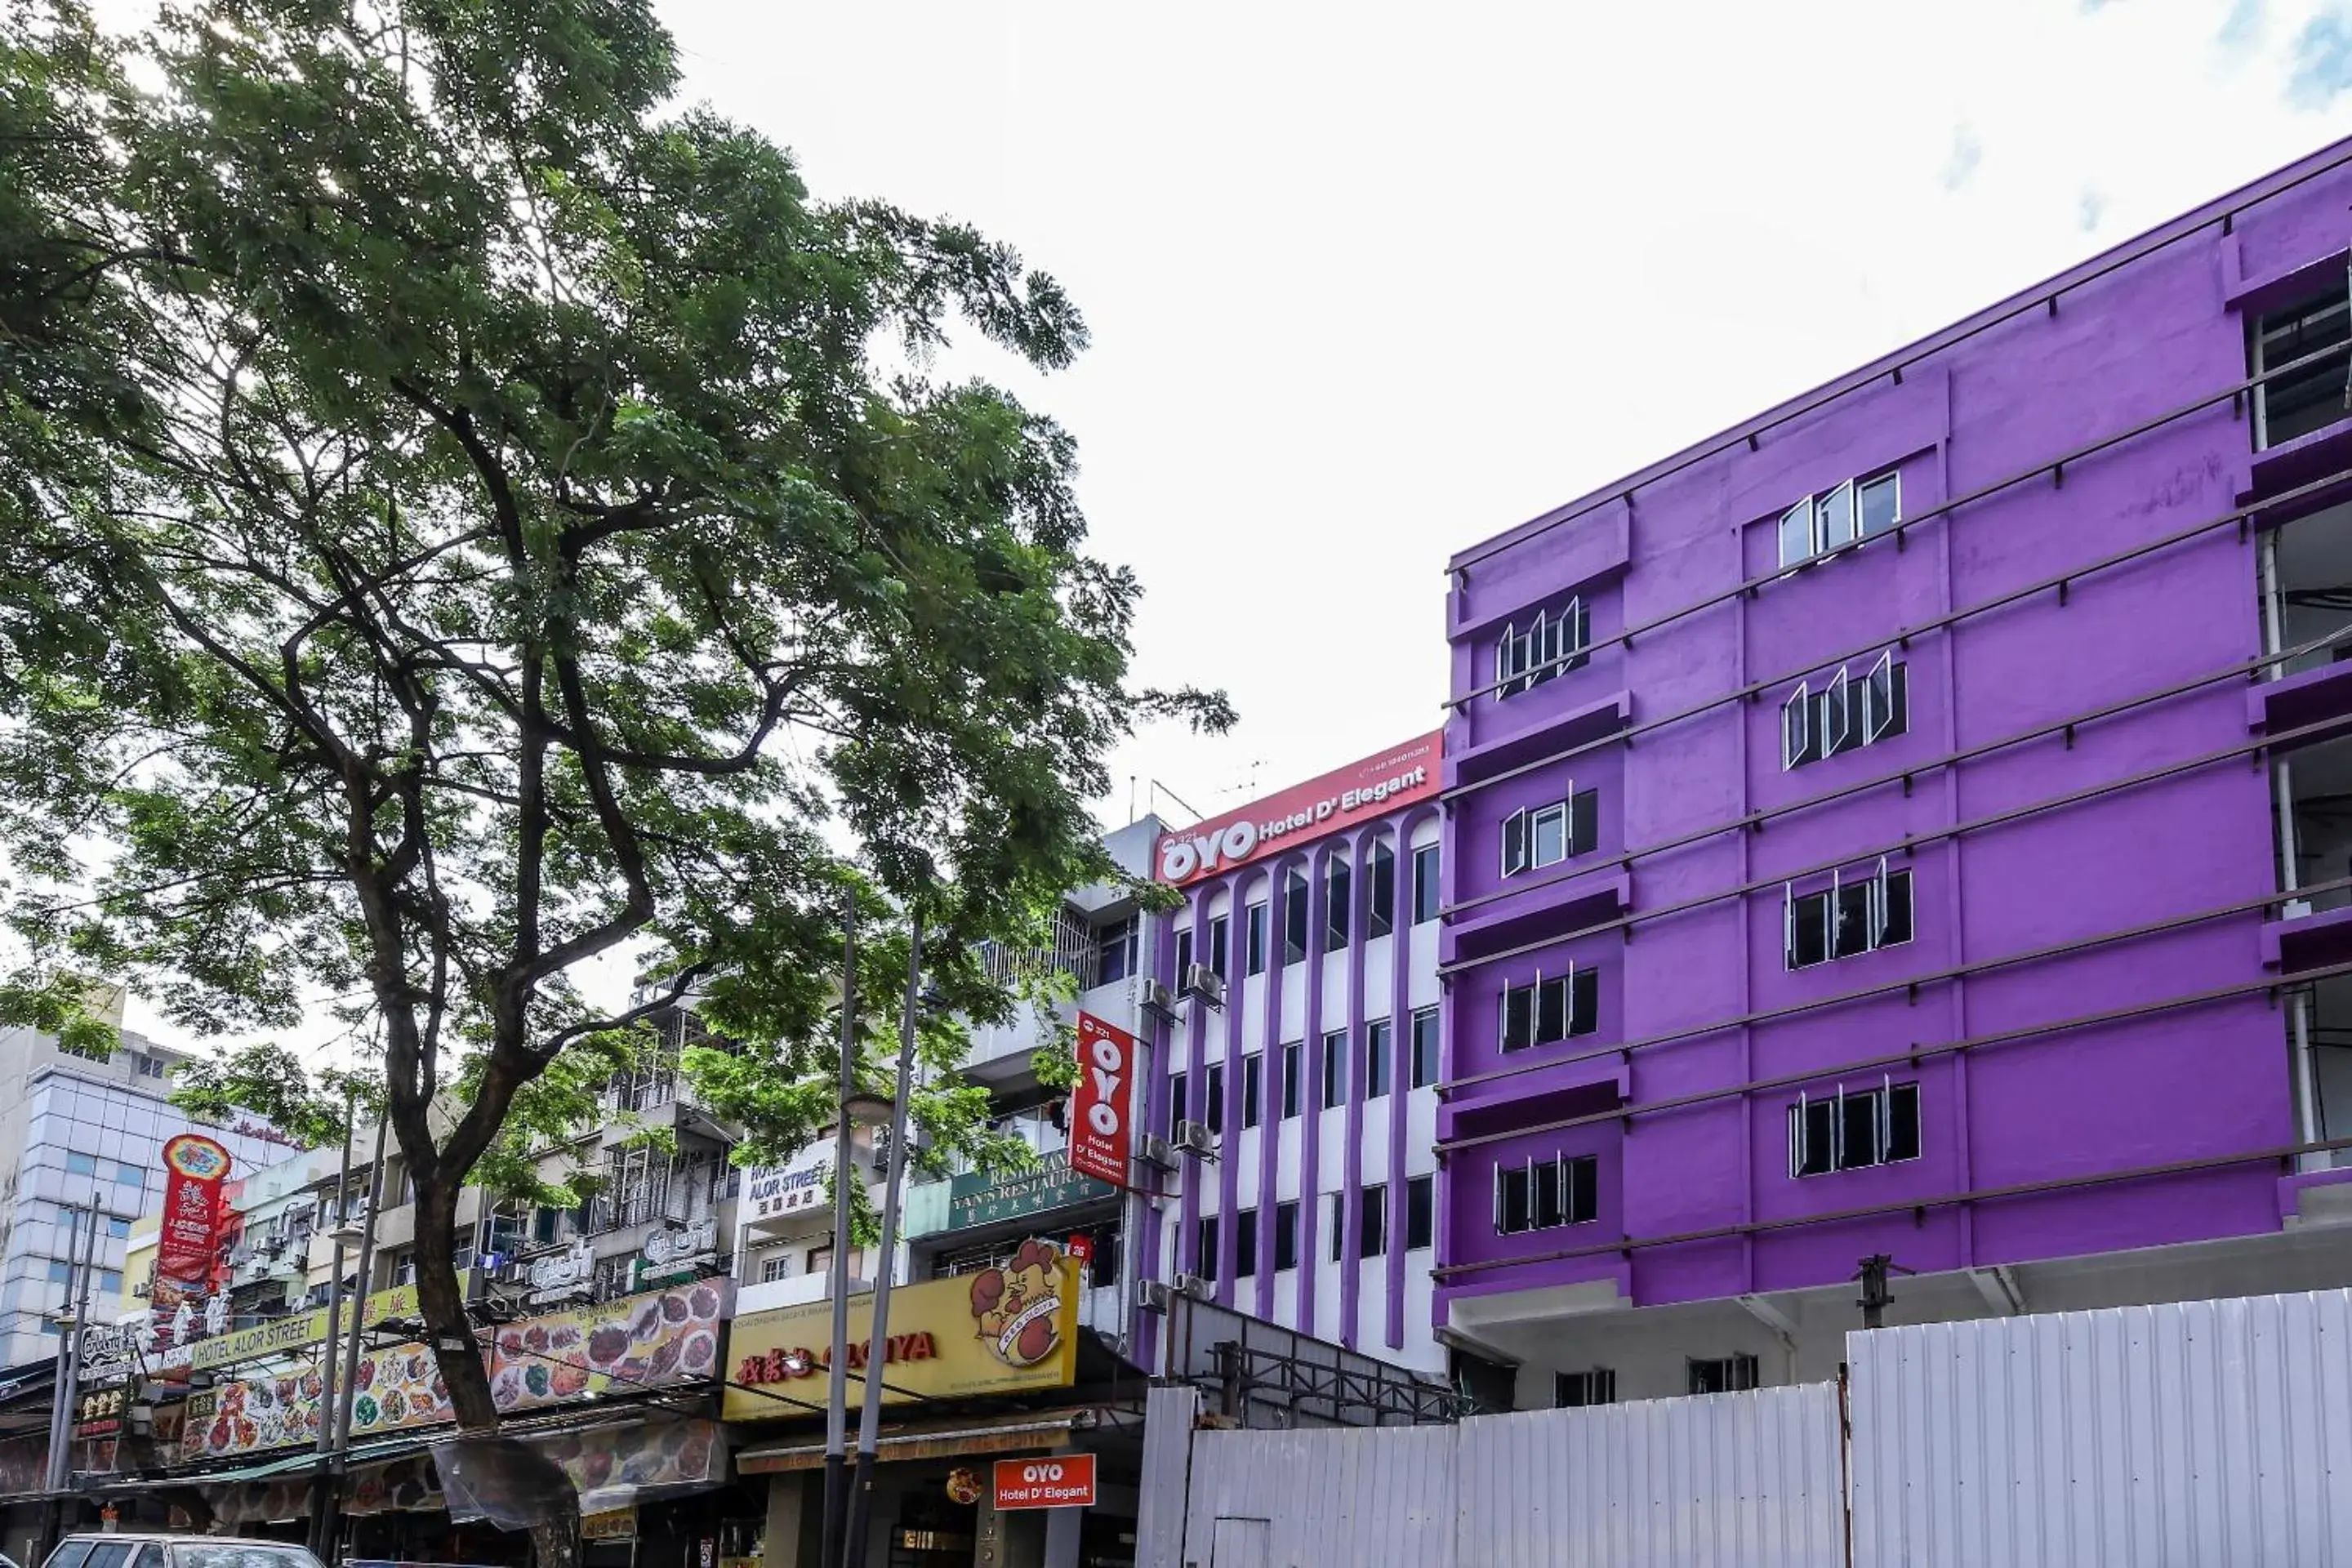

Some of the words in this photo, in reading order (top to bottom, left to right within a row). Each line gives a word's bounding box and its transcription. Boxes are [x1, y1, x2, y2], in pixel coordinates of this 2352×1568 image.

[1162, 821, 1257, 881] OYO
[1258, 806, 1313, 841] Hotel
[1316, 796, 1339, 820] D'
[1341, 764, 1425, 811] Elegant
[1088, 1039, 1122, 1136] OYO
[1088, 1135, 1113, 1152] Hotel
[1088, 1149, 1122, 1169] Elegant
[750, 1178, 780, 1202] ALOR
[782, 1168, 819, 1193] STREE
[198, 1340, 231, 1365] HOTEL
[234, 1330, 263, 1352] ALOR
[266, 1318, 313, 1345] STREET
[1022, 1463, 1063, 1483] OYO
[1000, 1488, 1028, 1501] Hotel
[1031, 1487, 1042, 1499] D'
[1045, 1486, 1089, 1500] Elegant
